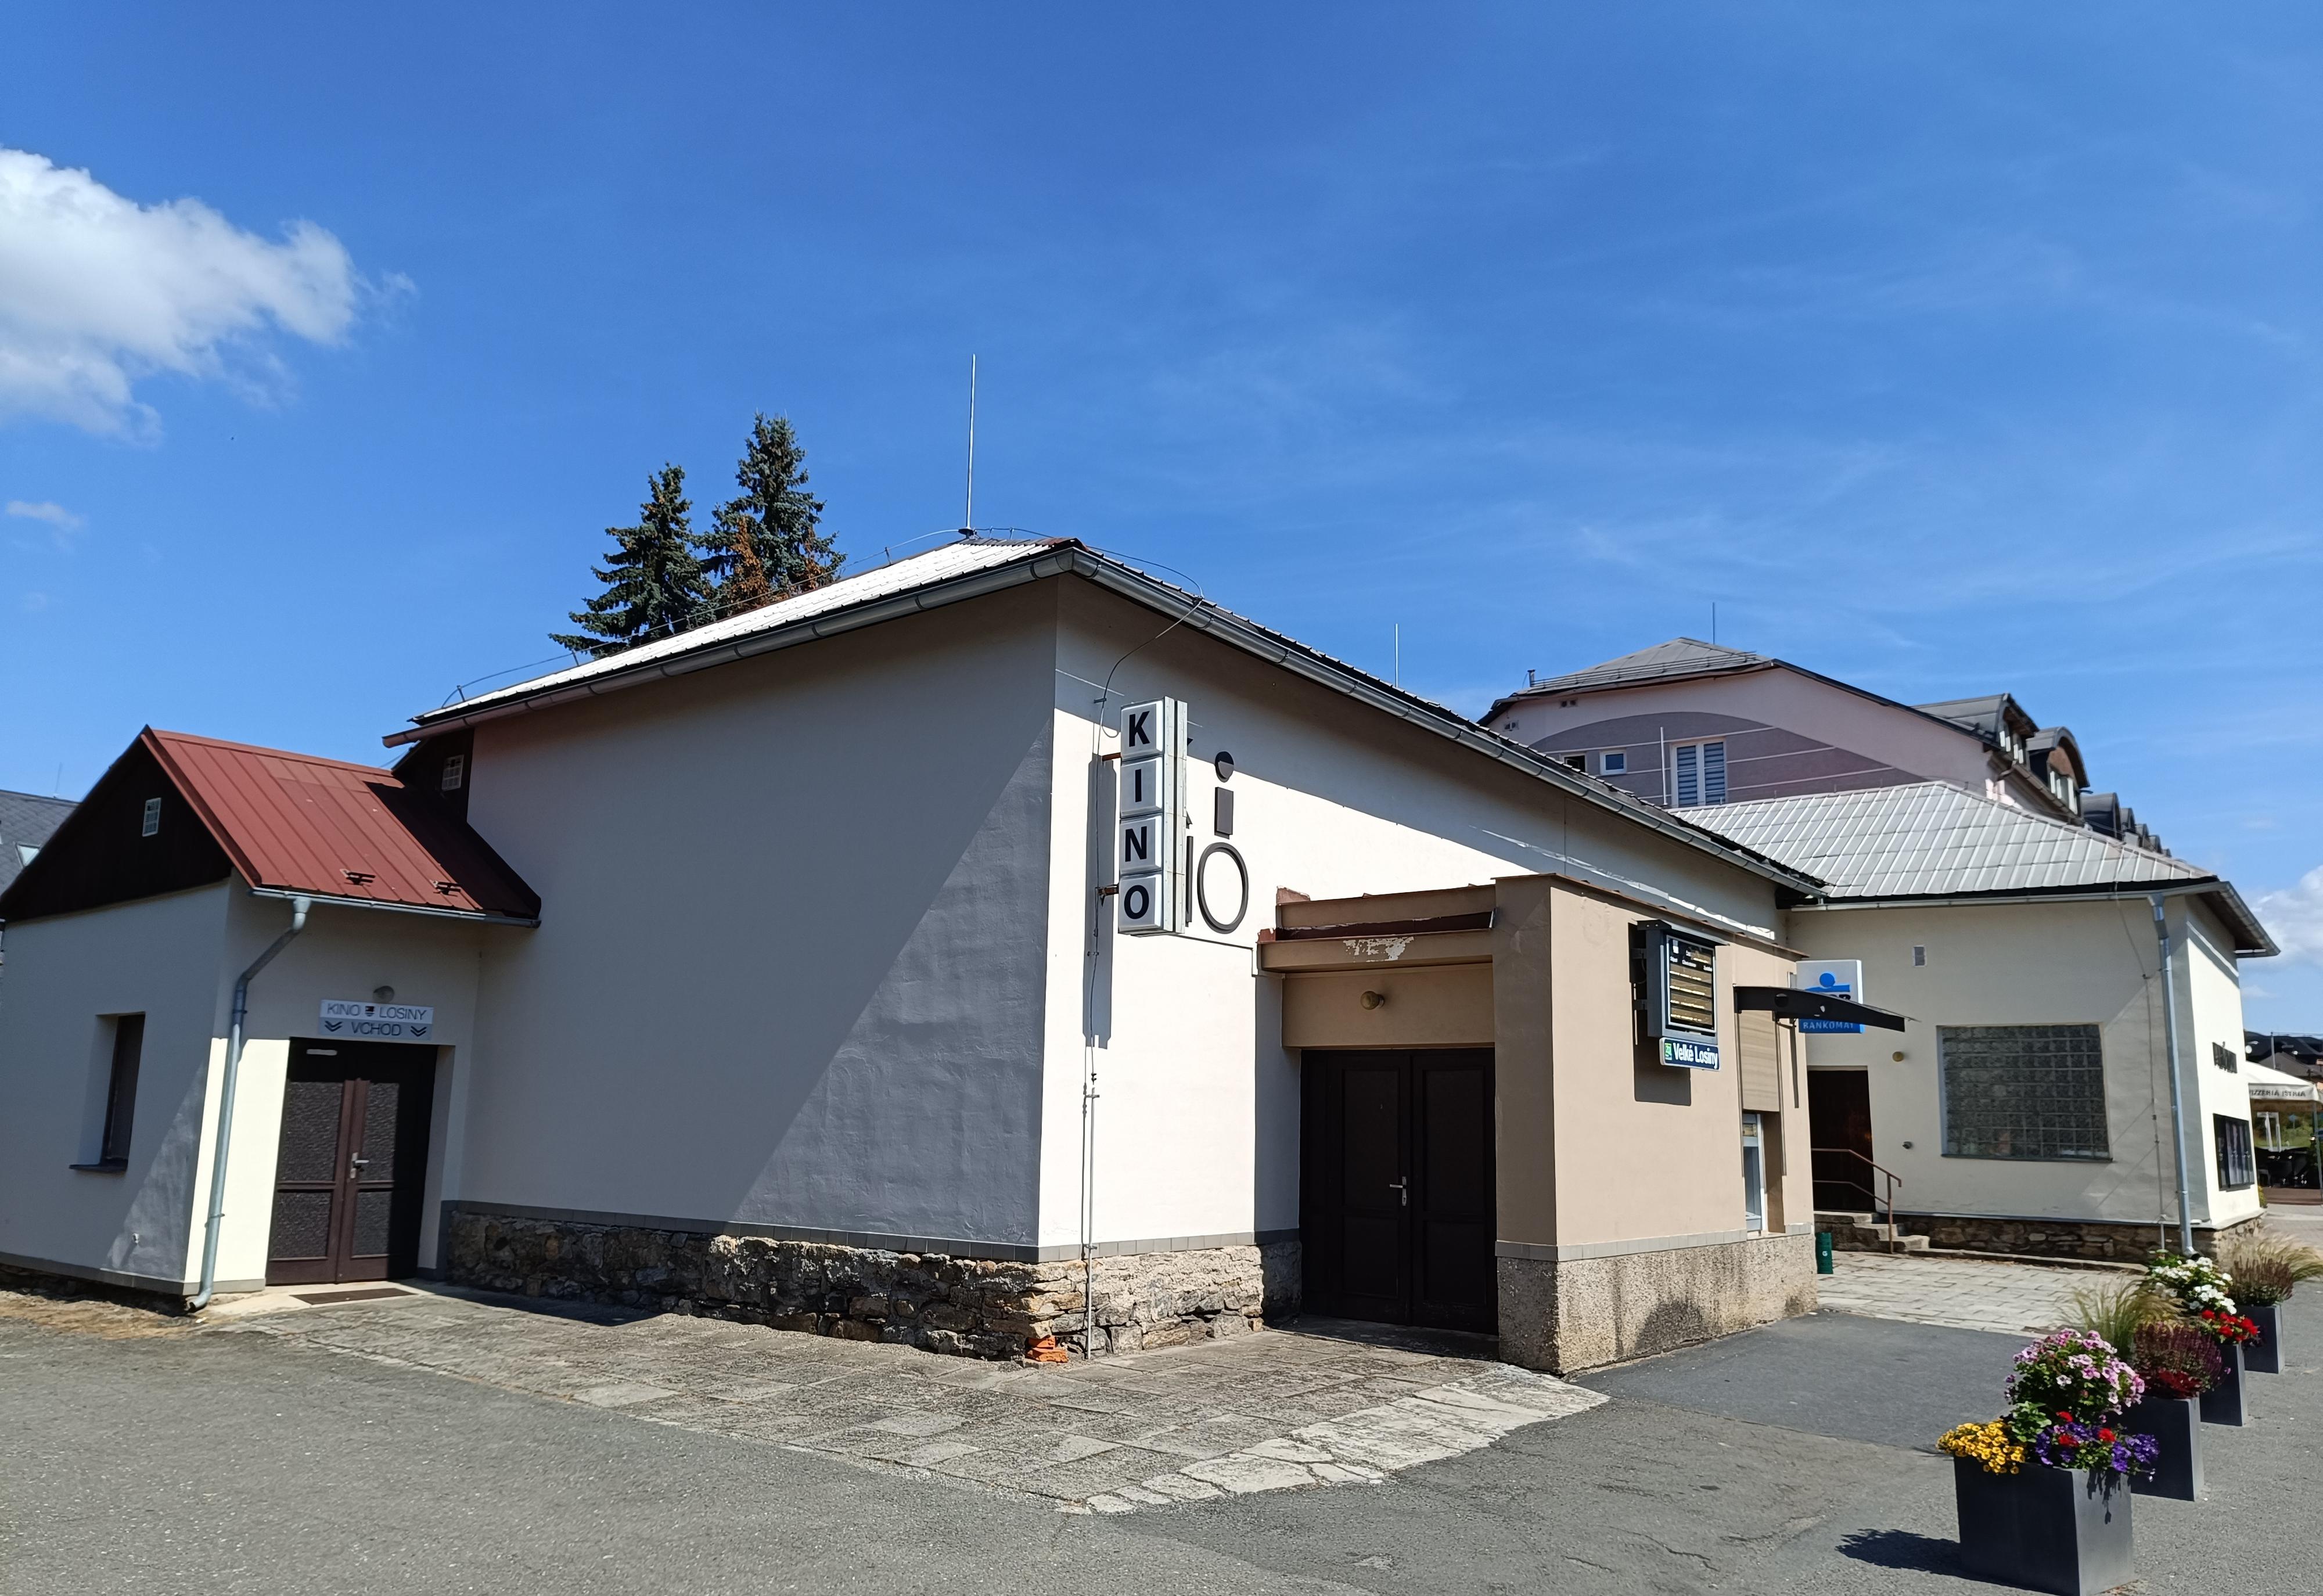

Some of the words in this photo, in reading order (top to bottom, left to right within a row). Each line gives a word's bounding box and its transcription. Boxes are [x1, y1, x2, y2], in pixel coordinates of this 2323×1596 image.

[1124, 710, 1150, 920] KINO
[327, 1003, 361, 1016] KINO
[379, 1007, 427, 1020] LOSINY
[351, 1022, 401, 1036] VCHOD
[1803, 1021, 1854, 1029] BANKOMAT
[1673, 1043, 1694, 1062] Velké
[1694, 1046, 1718, 1069] Losiny
